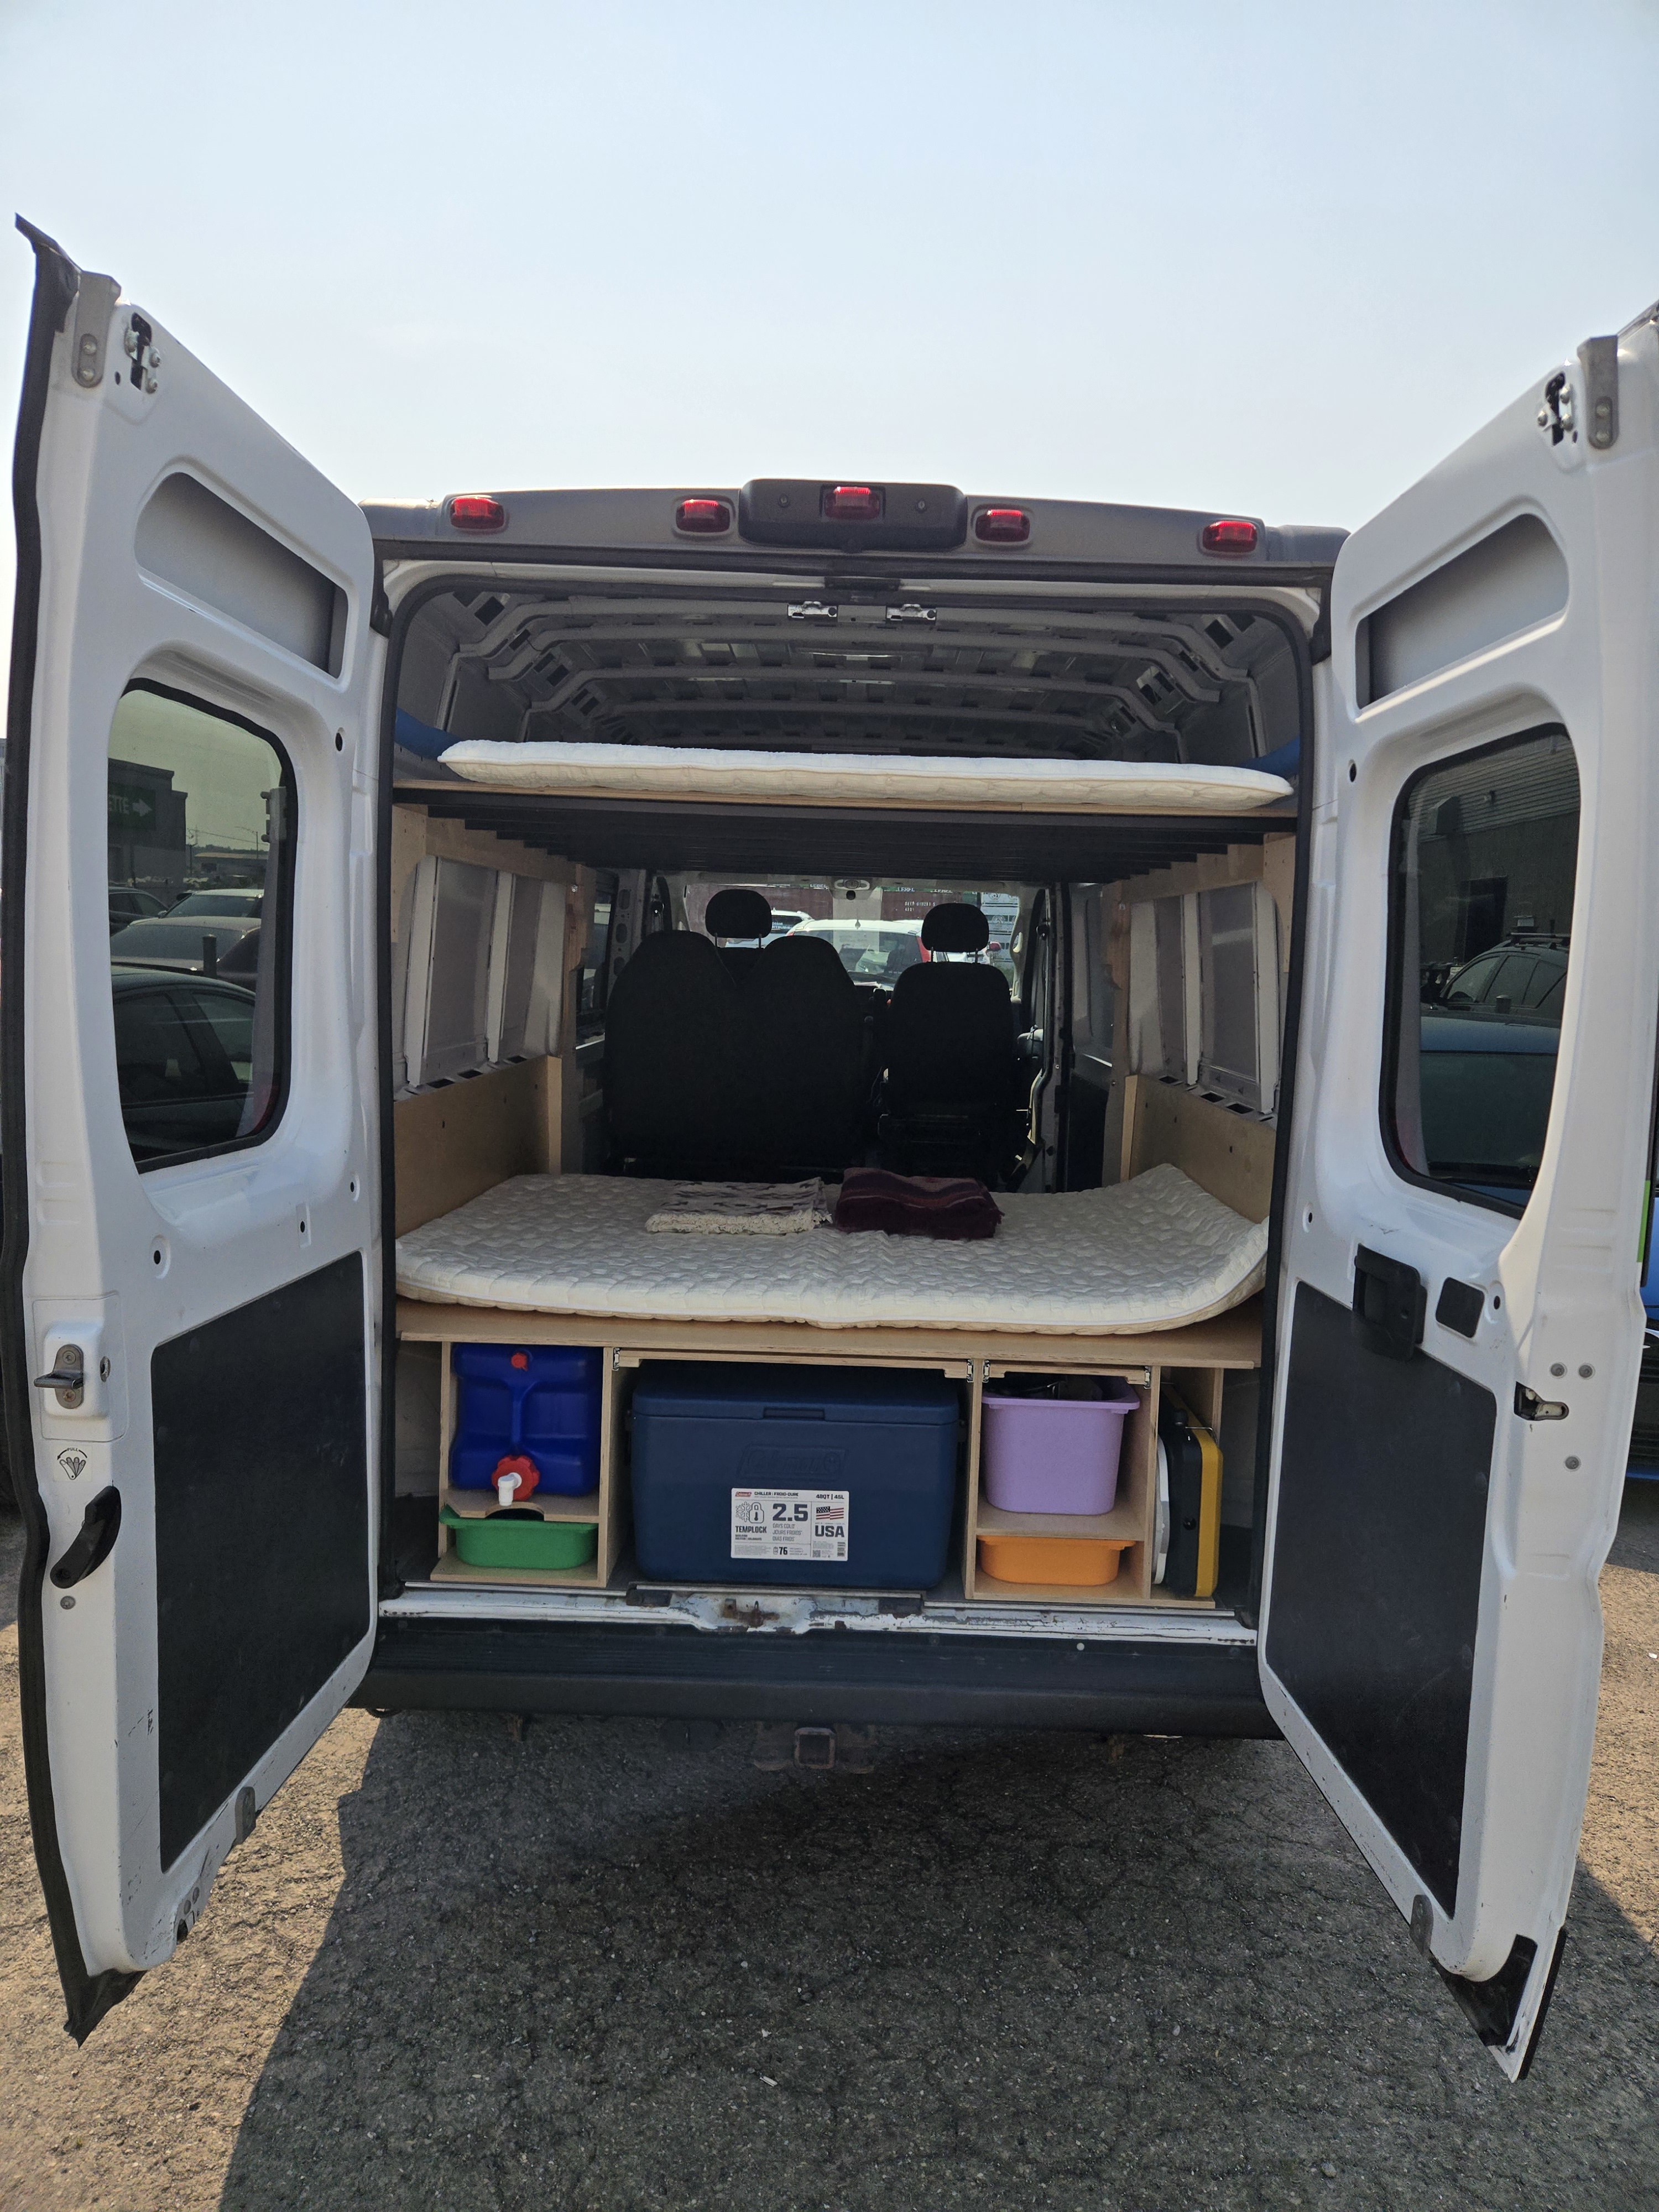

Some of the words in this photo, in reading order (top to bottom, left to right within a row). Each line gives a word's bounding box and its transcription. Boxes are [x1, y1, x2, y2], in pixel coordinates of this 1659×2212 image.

[773, 1503, 808, 1521] 2.5
[735, 1525, 767, 1533] TEMPLOCK
[815, 1525, 845, 1538] USA
[779, 1546, 788, 1555] 76
